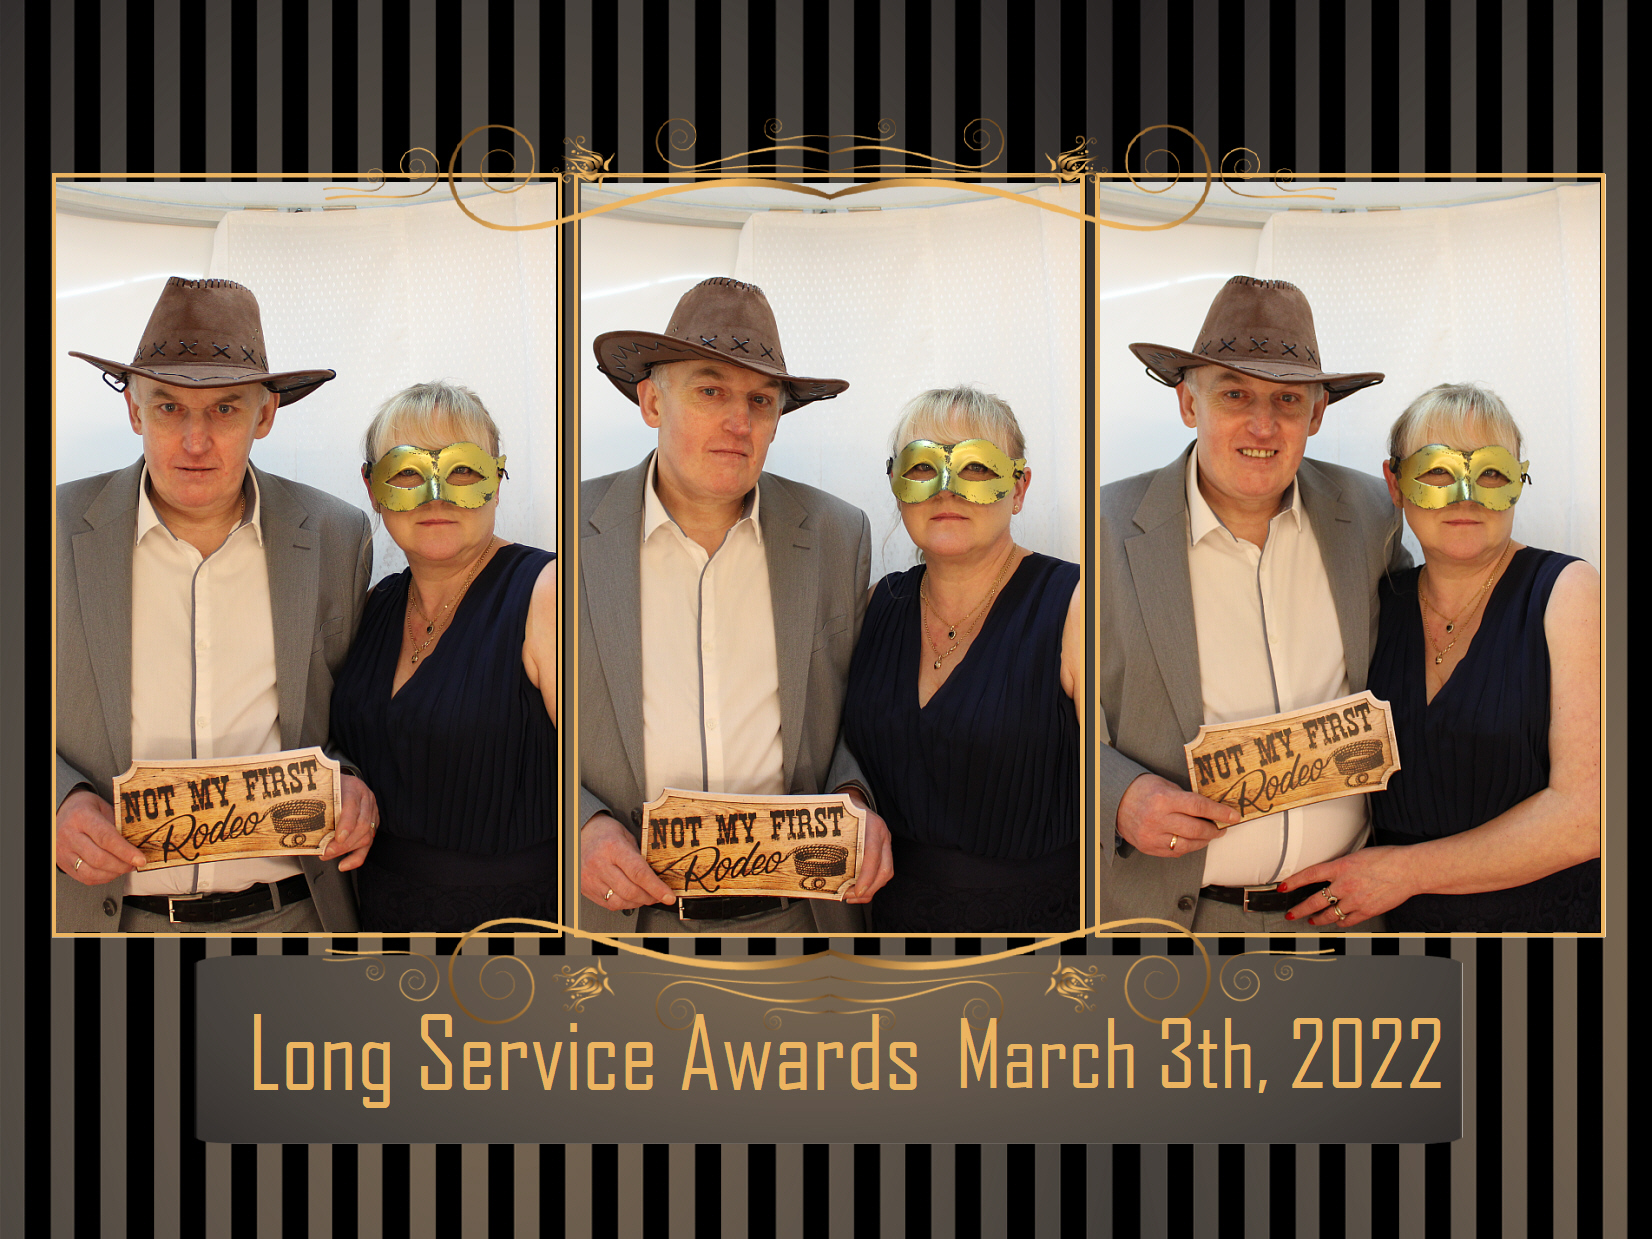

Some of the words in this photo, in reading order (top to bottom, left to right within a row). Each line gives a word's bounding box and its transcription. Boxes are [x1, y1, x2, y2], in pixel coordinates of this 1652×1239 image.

[1193, 745, 1245, 786] NOT
[1254, 728, 1294, 767] MY
[1303, 703, 1373, 749] FIRST
[120, 785, 175, 824] NOT
[187, 775, 230, 812] MY
[242, 760, 318, 801] FIRST
[1217, 754, 1330, 817] Rodeo
[137, 804, 266, 863] Rodeo
[651, 816, 702, 849] NOT
[716, 813, 756, 845] MY
[770, 806, 843, 840] FIRST
[657, 841, 789, 893] Rodeo
